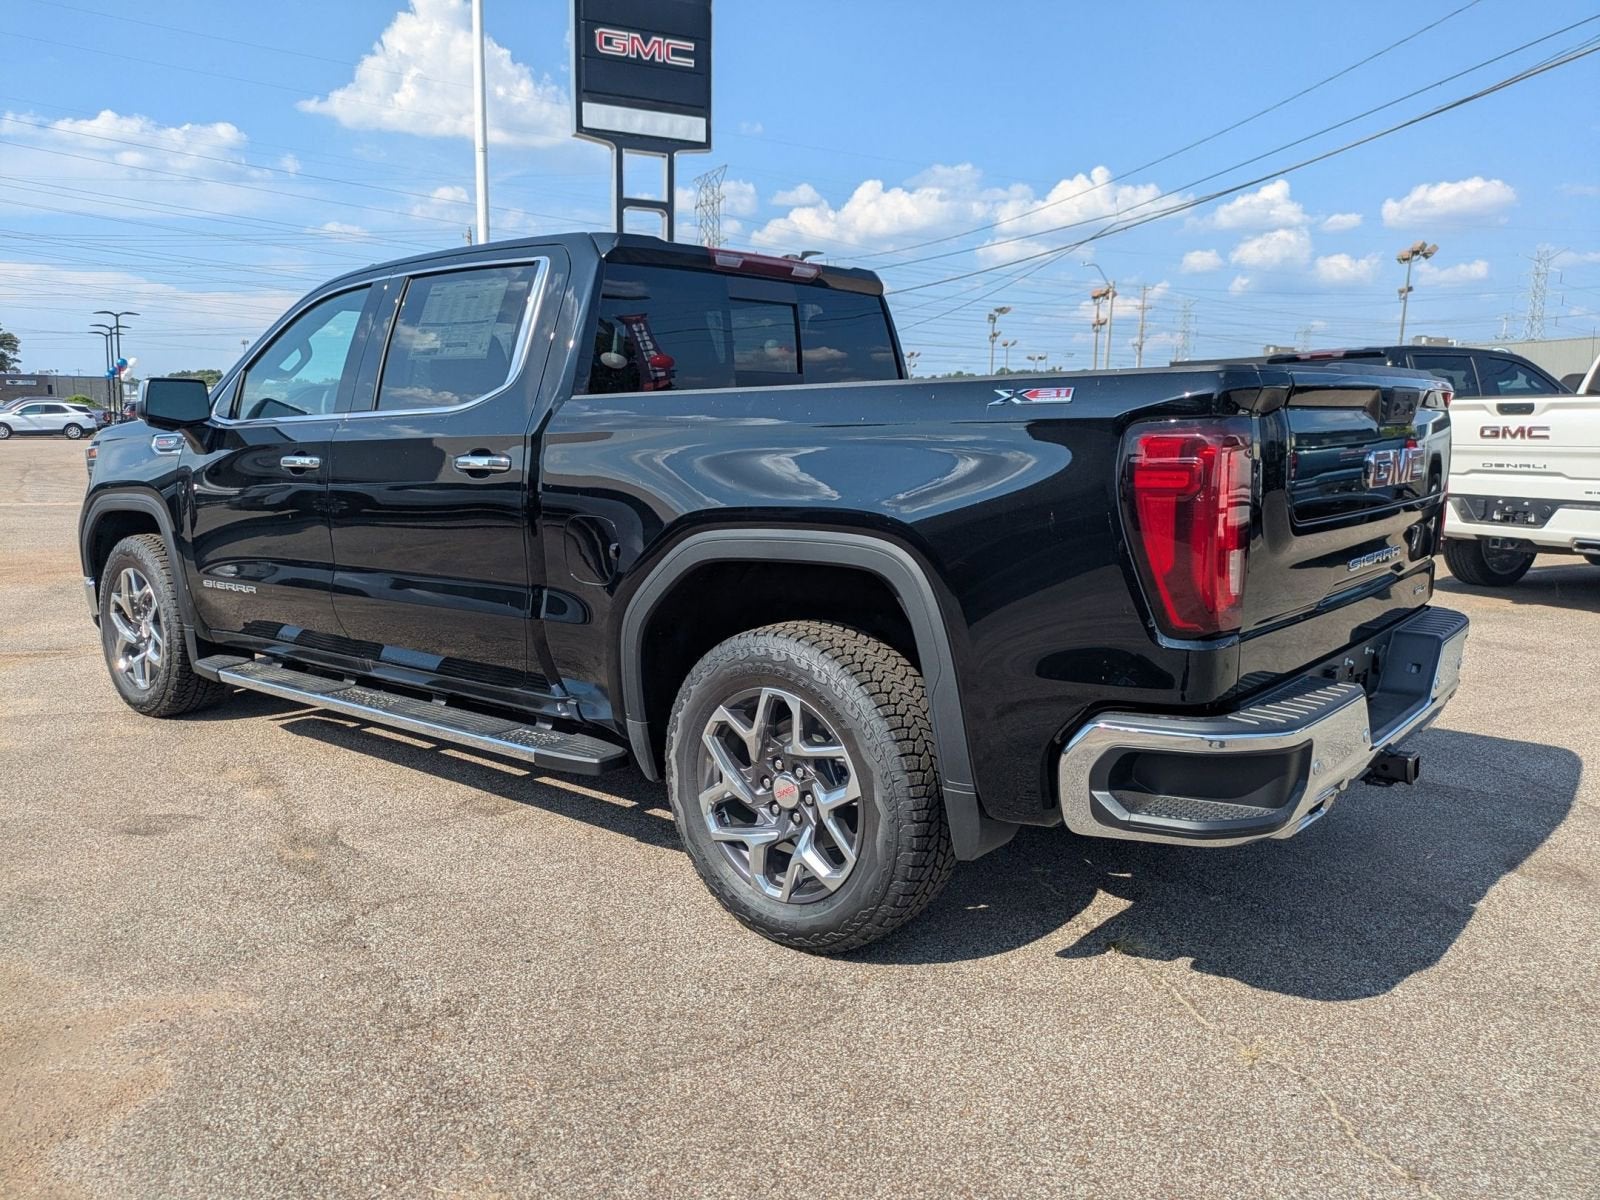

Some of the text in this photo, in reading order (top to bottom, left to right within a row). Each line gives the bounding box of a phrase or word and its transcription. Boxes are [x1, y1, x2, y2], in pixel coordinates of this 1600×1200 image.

[595, 28, 695, 67] GMC
[977, 387, 1075, 406] X31
[1480, 425, 1550, 440] GMC
[1364, 448, 1426, 489] GMC
[1481, 462, 1548, 470] DENALI
[1347, 546, 1400, 572] SIERRA
[203, 579, 257, 594] SIERRA
